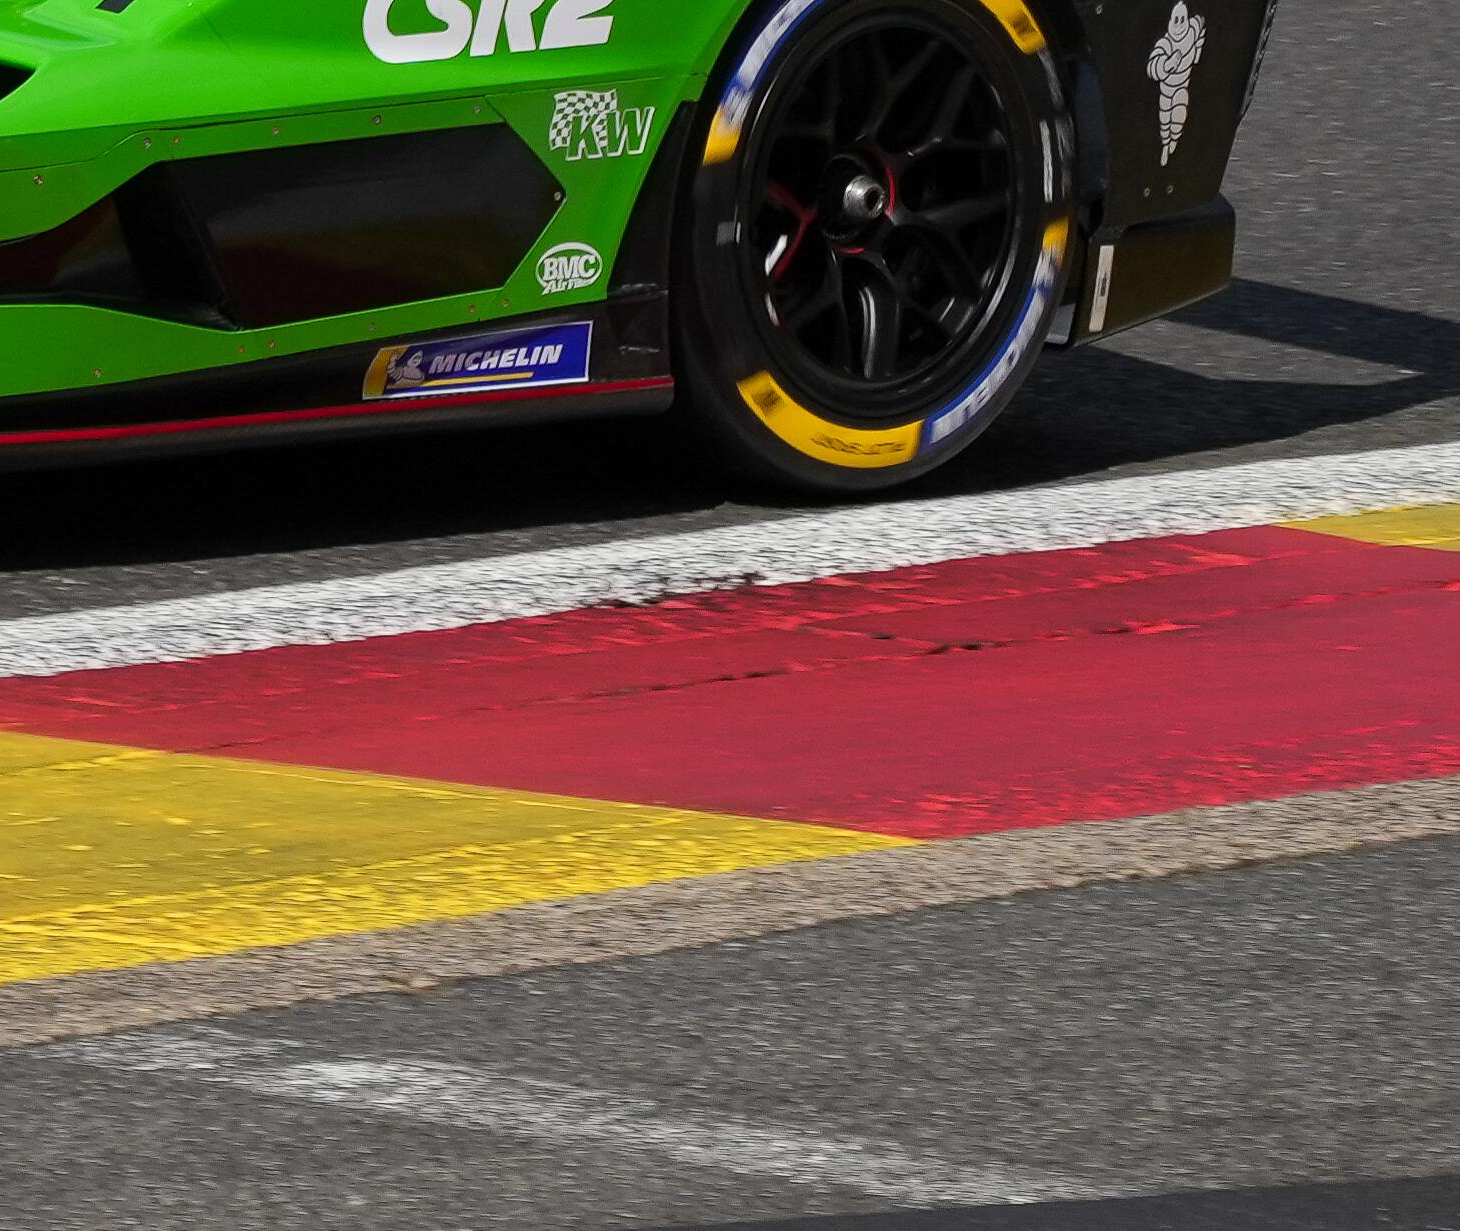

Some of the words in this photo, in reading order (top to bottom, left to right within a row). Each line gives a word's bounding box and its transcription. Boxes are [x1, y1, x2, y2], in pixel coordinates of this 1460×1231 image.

[565, 105, 656, 162] KW
[543, 254, 596, 281] BMC
[428, 343, 563, 374] MICHELIN
